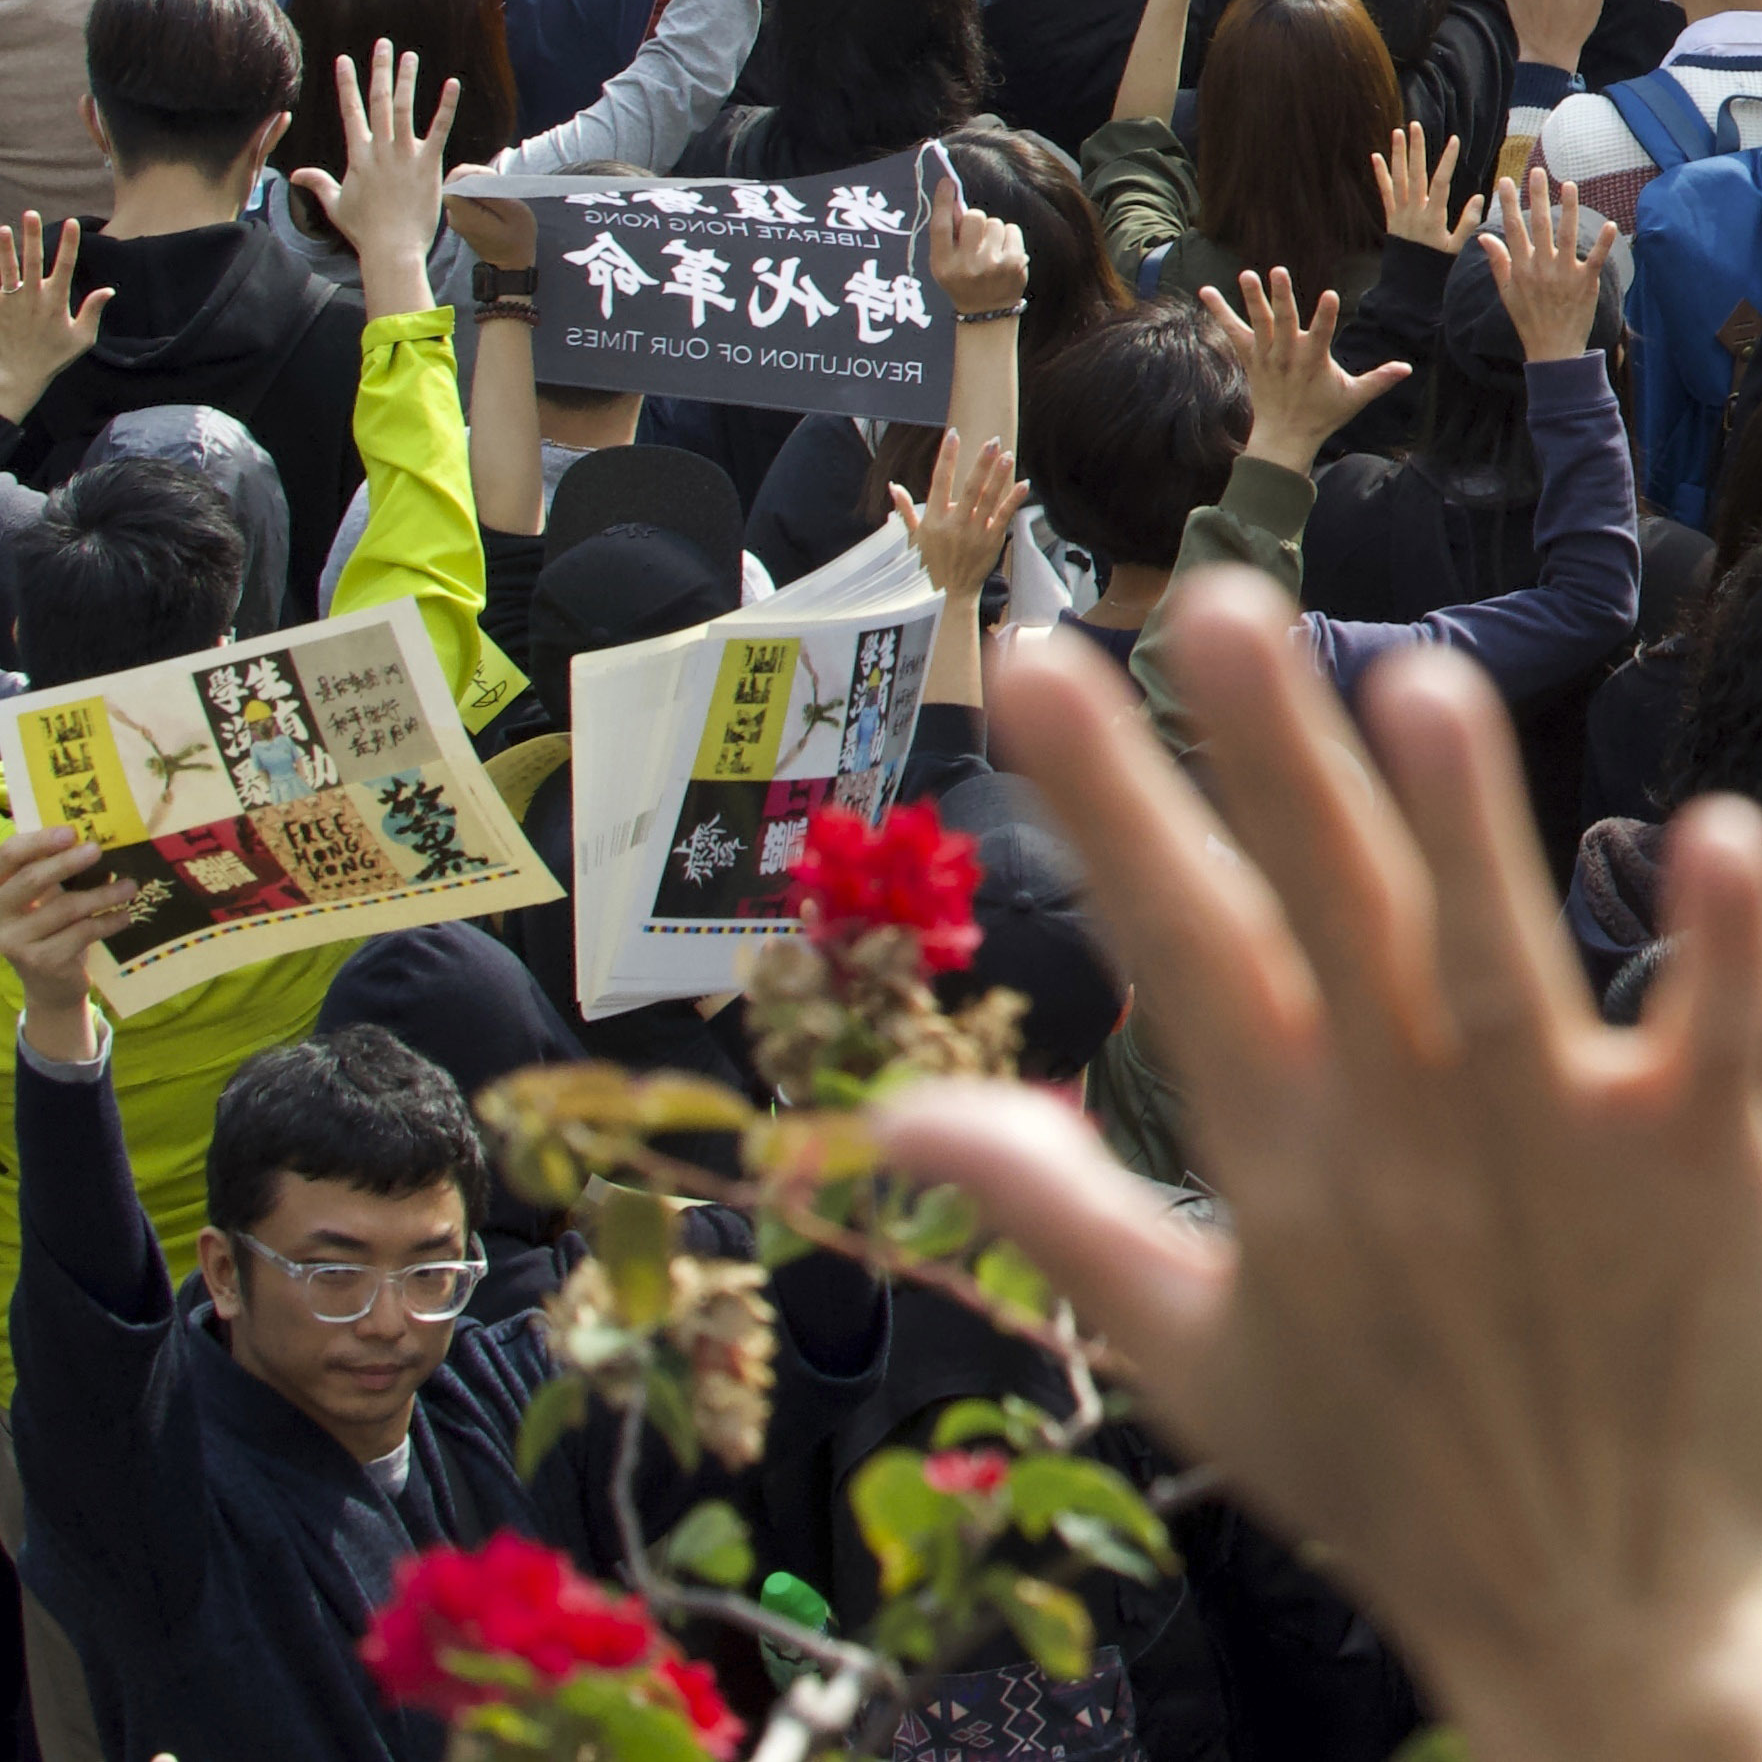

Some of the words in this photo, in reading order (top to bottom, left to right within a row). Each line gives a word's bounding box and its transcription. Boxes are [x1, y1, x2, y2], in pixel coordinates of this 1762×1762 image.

[208, 656, 293, 715] 學生
[284, 812, 352, 850] FREE
[294, 836, 359, 866] HONG
[307, 850, 376, 883] KONG
